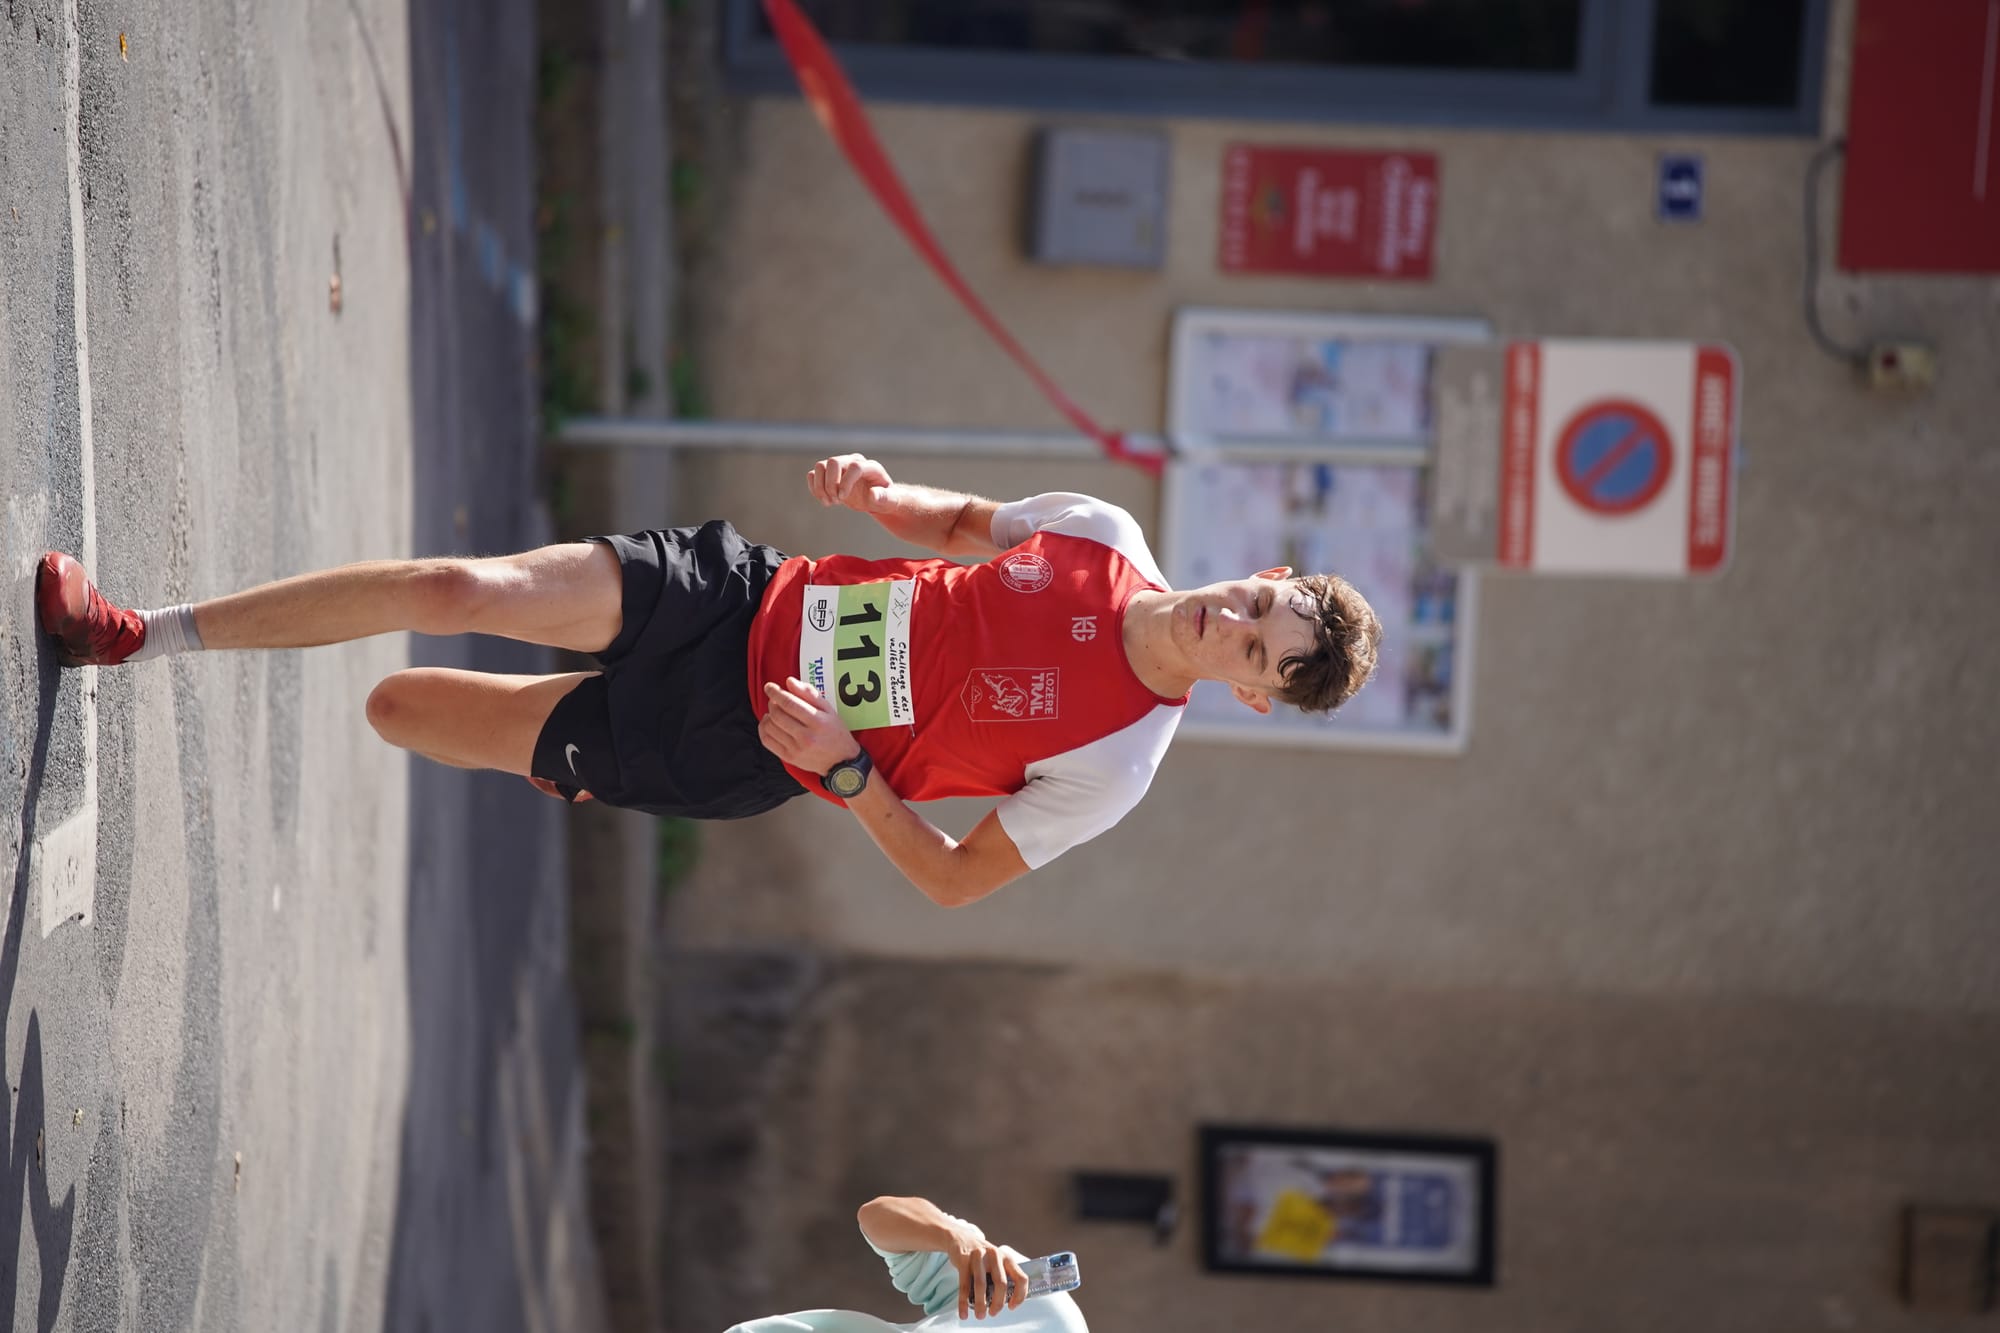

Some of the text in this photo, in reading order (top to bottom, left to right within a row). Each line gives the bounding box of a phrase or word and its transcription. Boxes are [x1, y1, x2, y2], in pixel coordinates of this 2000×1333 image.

[817, 600, 827, 627] BFP
[837, 602, 882, 707] 113
[898, 642, 907, 689] Challenge
[890, 638, 900, 718] vallées cévenoles
[1030, 673, 1044, 715] TRAIL
[1044, 672, 1056, 714] LOZÈRE
